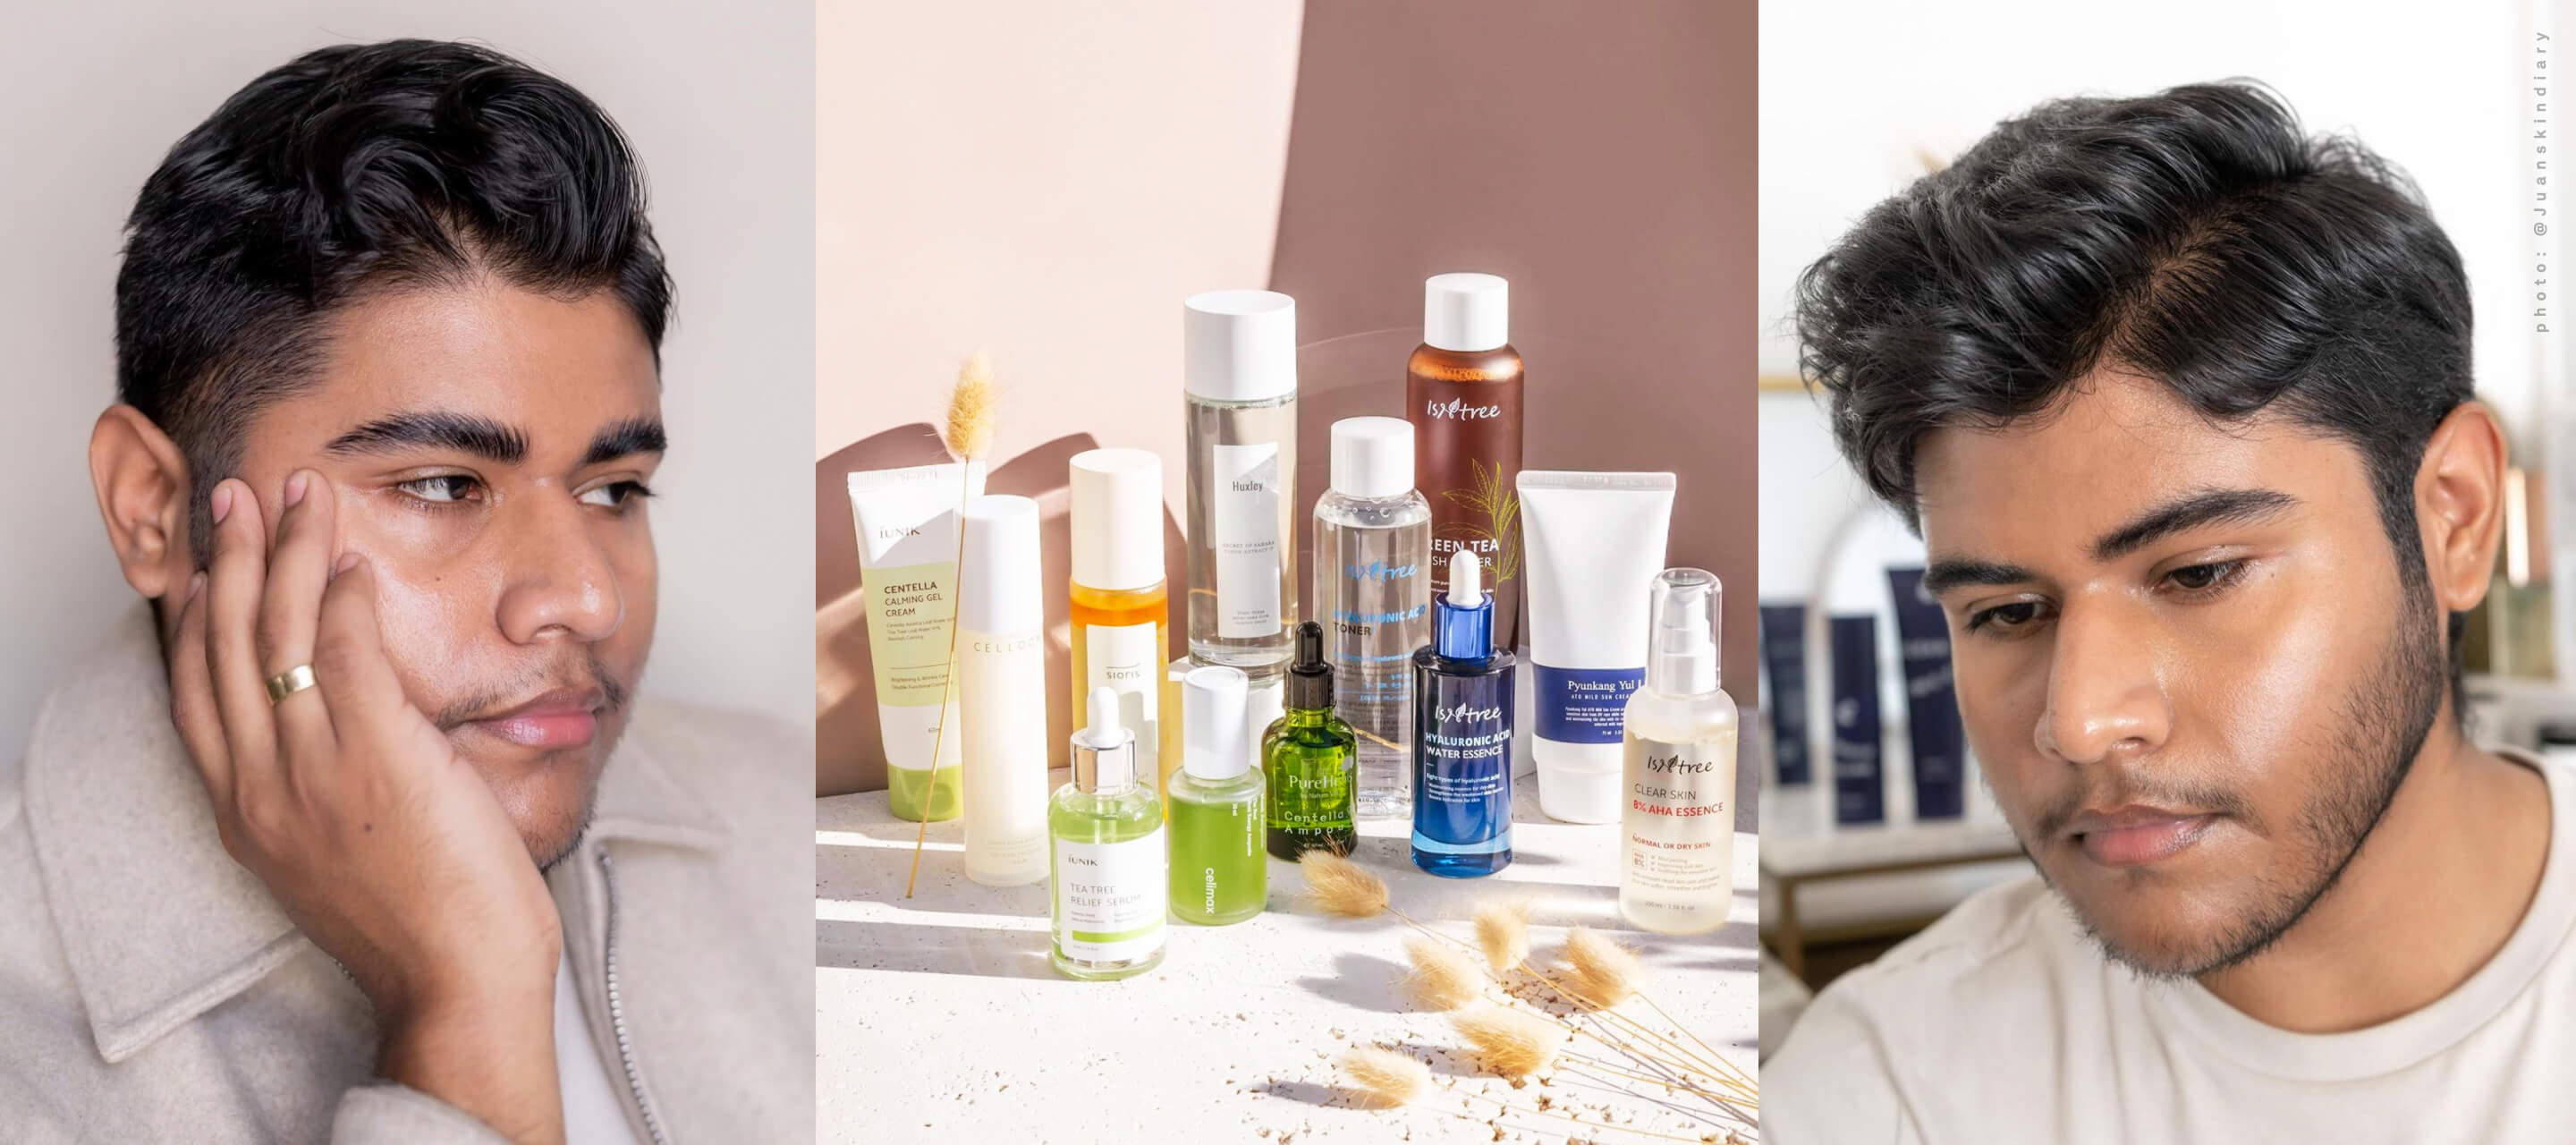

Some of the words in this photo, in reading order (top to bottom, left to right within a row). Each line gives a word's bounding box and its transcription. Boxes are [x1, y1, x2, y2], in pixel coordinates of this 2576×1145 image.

[1232, 480, 1263, 492] Huxley
[1470, 538, 1500, 552] TEA
[884, 581, 937, 594] CENTELLA
[885, 595, 924, 606] CALMING
[926, 593, 943, 601] GEL
[886, 608, 916, 616] CREAM
[1333, 622, 1371, 636] TONER
[1106, 671, 1140, 680] sioris
[1567, 680, 1615, 692] Pyunkang
[1619, 680, 1635, 690] Yul
[1425, 732, 1492, 747] HYALURONIC
[1492, 729, 1511, 743] ACID
[1426, 745, 1461, 759] WATER
[1462, 744, 1504, 759] ESSENCE
[1634, 783, 1667, 799] CLEAR
[1670, 789, 1697, 801] SKIN
[1633, 800, 1646, 812] 8%
[1648, 805, 1673, 816] AHA
[1675, 802, 1724, 817] ESSENCE
[1284, 809, 1344, 823] Centella
[1284, 823, 1344, 836] Ampou
[1632, 833, 1662, 849] NORMAL
[1071, 882, 1088, 894] TEA
[1090, 886, 1116, 895] TREE
[1205, 867, 1216, 914] celimax
[1071, 895, 1102, 907] RELIEF
[1107, 894, 1141, 907] SERUM
